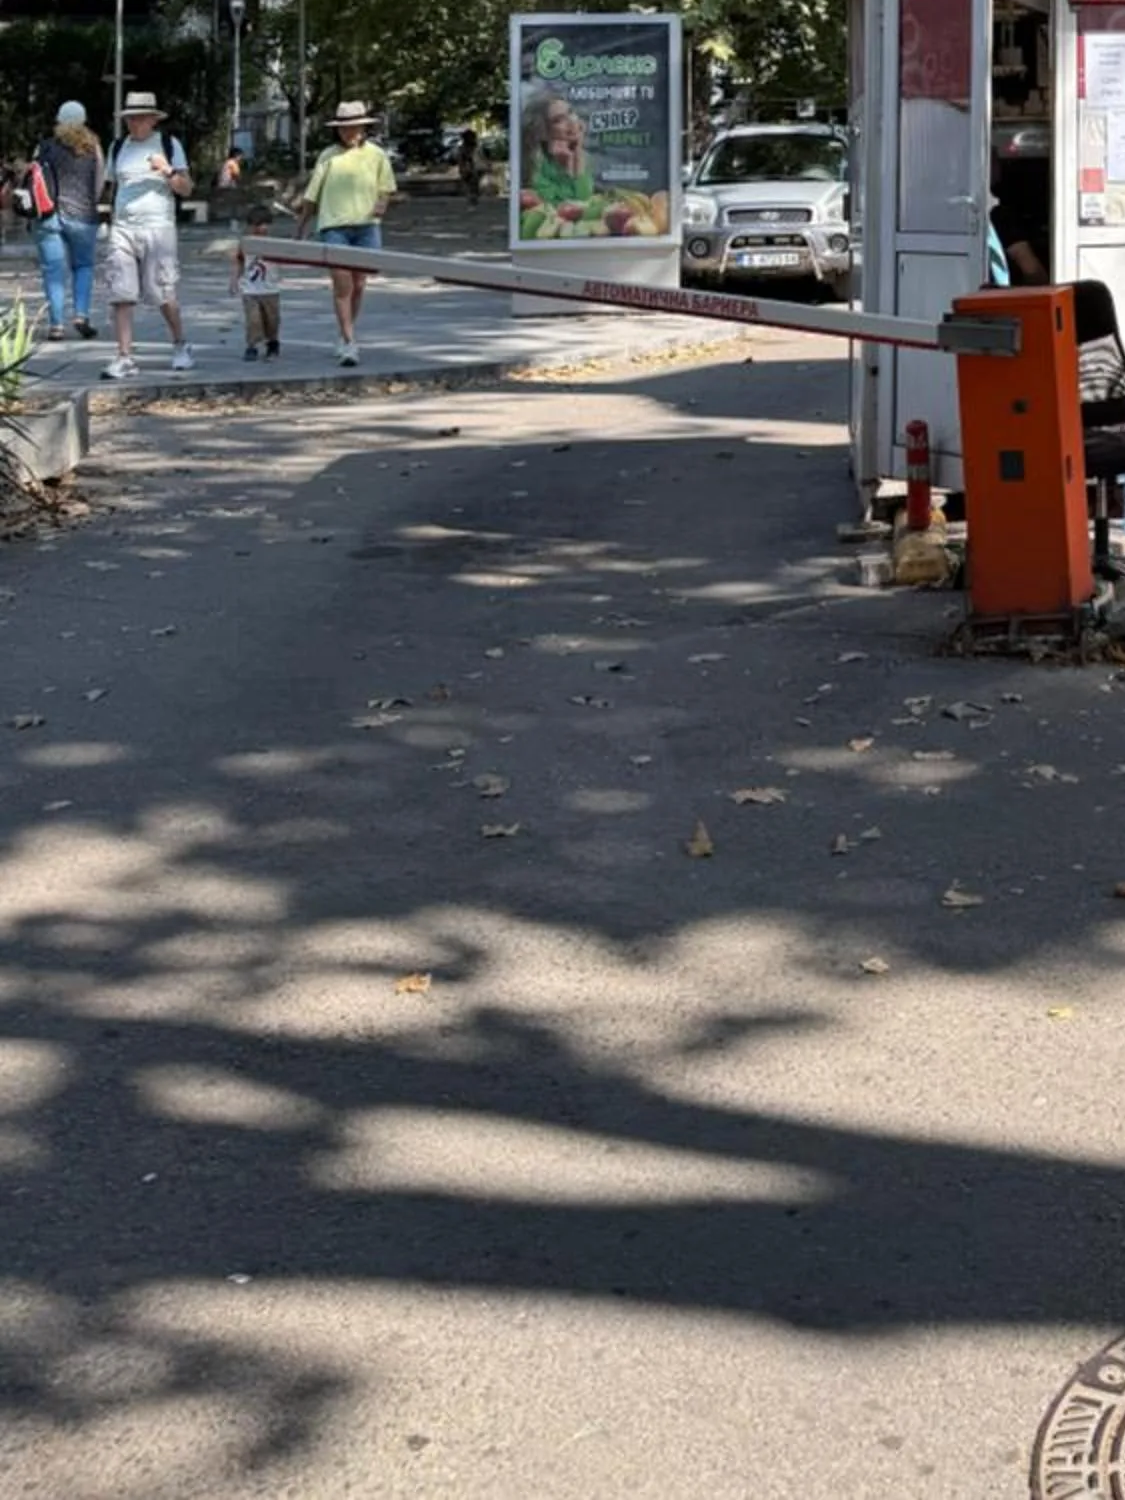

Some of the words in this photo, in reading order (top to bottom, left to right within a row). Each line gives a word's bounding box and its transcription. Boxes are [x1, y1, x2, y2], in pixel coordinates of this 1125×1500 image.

[591, 107, 639, 131] СУПЕР
[583, 279, 688, 308] АВТОМАТИЧНА
[691, 294, 760, 317] БАРИЕРА
